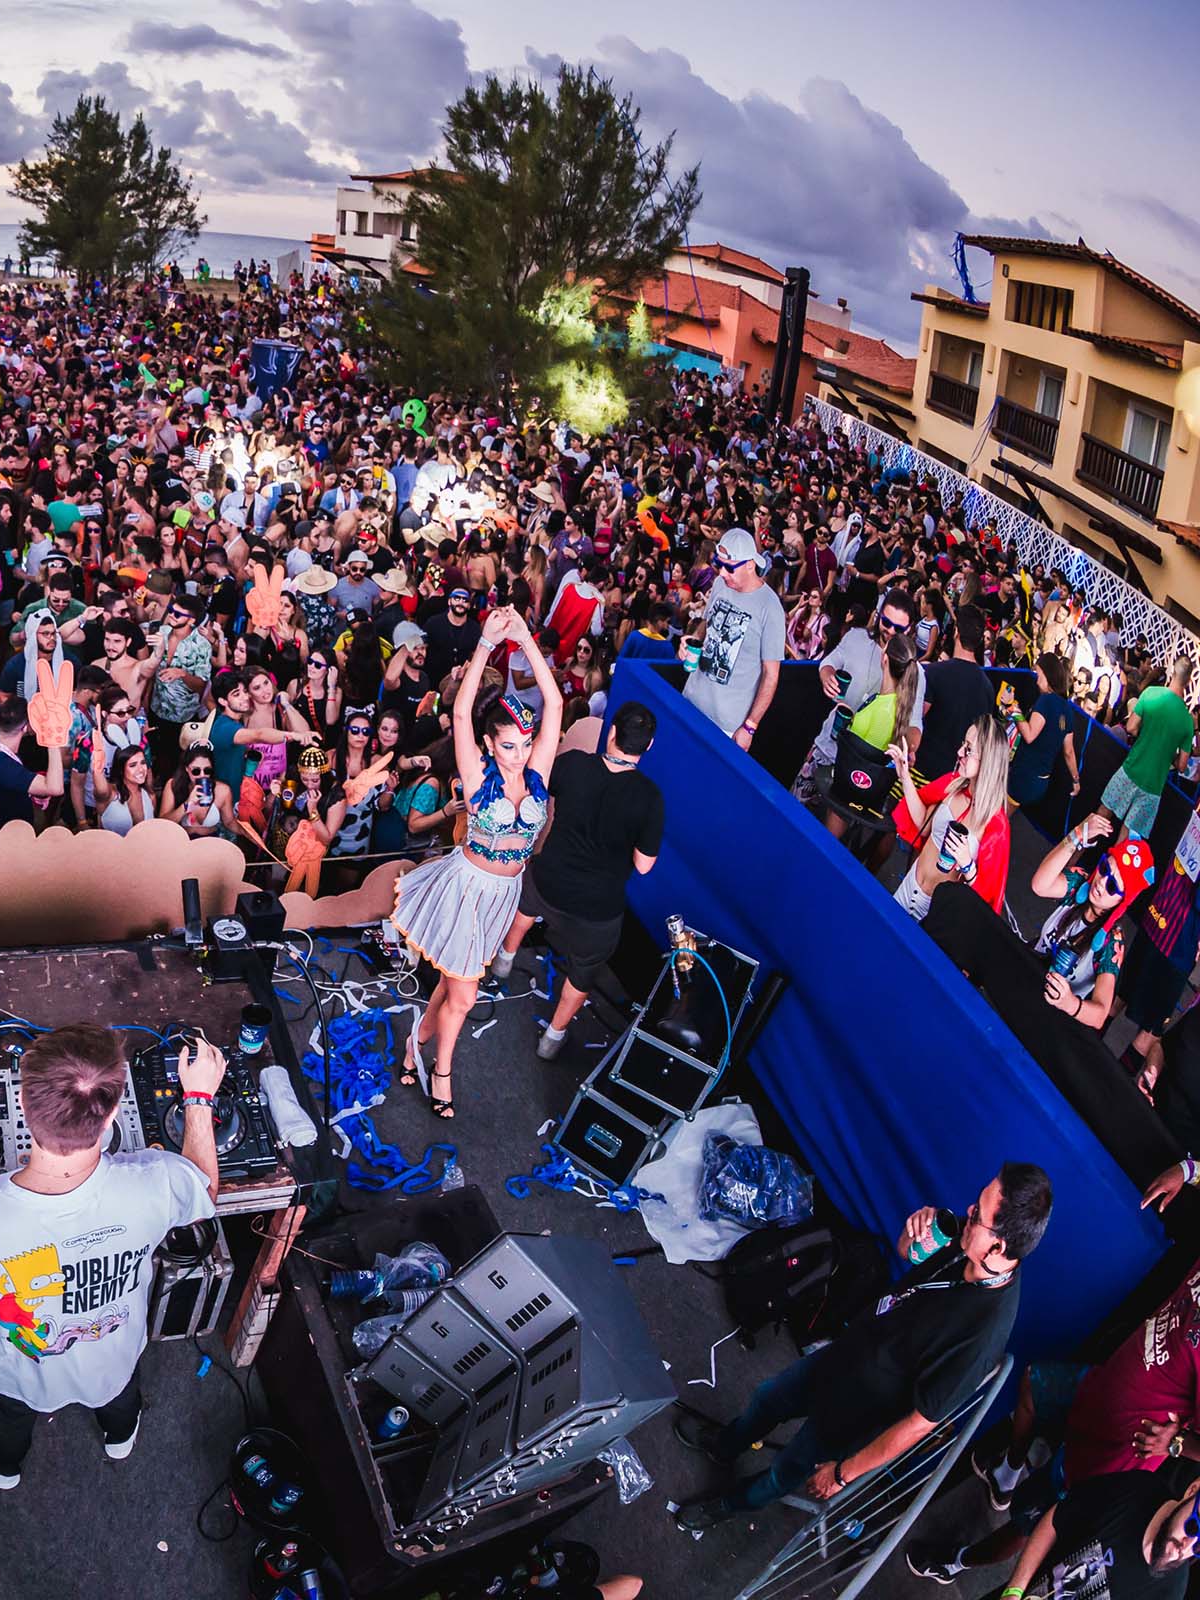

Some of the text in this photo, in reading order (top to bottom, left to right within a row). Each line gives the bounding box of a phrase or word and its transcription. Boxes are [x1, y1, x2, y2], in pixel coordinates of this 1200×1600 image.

[61, 1250, 133, 1292] PUBLIC
[62, 1257, 144, 1314] ENEMY 1
